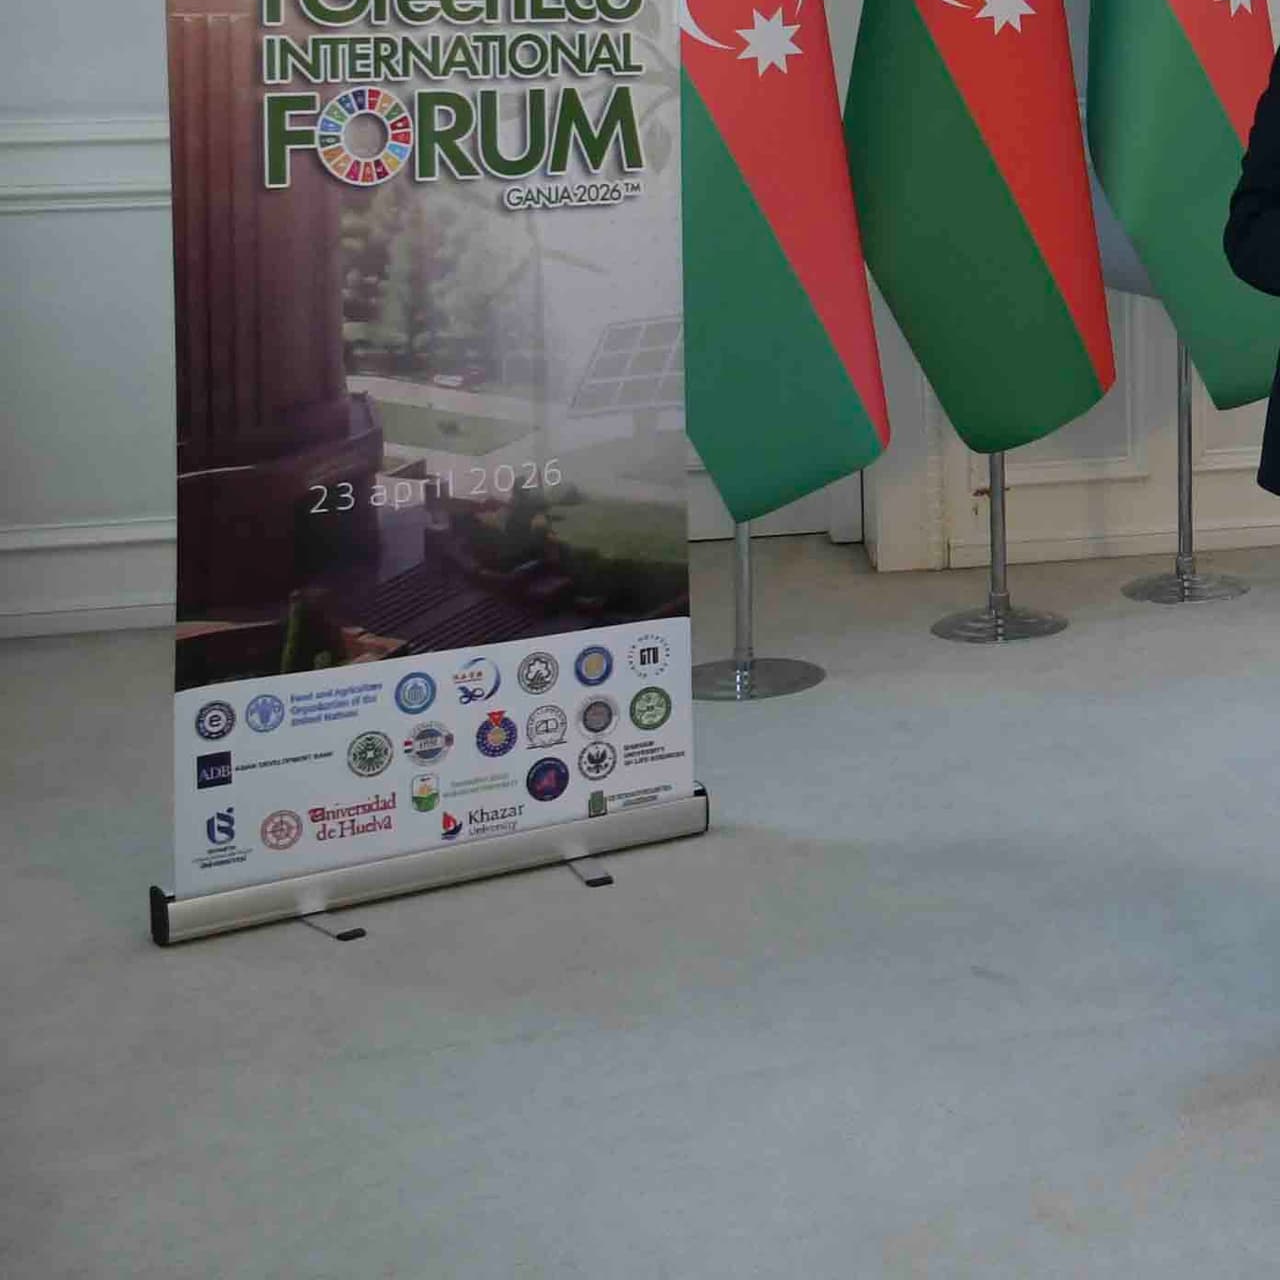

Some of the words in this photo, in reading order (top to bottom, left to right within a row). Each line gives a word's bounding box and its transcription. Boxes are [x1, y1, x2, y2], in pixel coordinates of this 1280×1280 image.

[264, 34, 643, 82] INTERNATIONAL
[264, 88, 643, 187] FORUM
[308, 483, 355, 514] 23
[369, 471, 454, 511] april
[469, 459, 562, 495] 2026
[639, 646, 659, 666] GTU
[198, 765, 230, 783] ADB
[308, 791, 397, 823] Universidad
[468, 802, 525, 825] Khazar
[316, 822, 337, 841] de
[338, 815, 393, 839] Huelva
